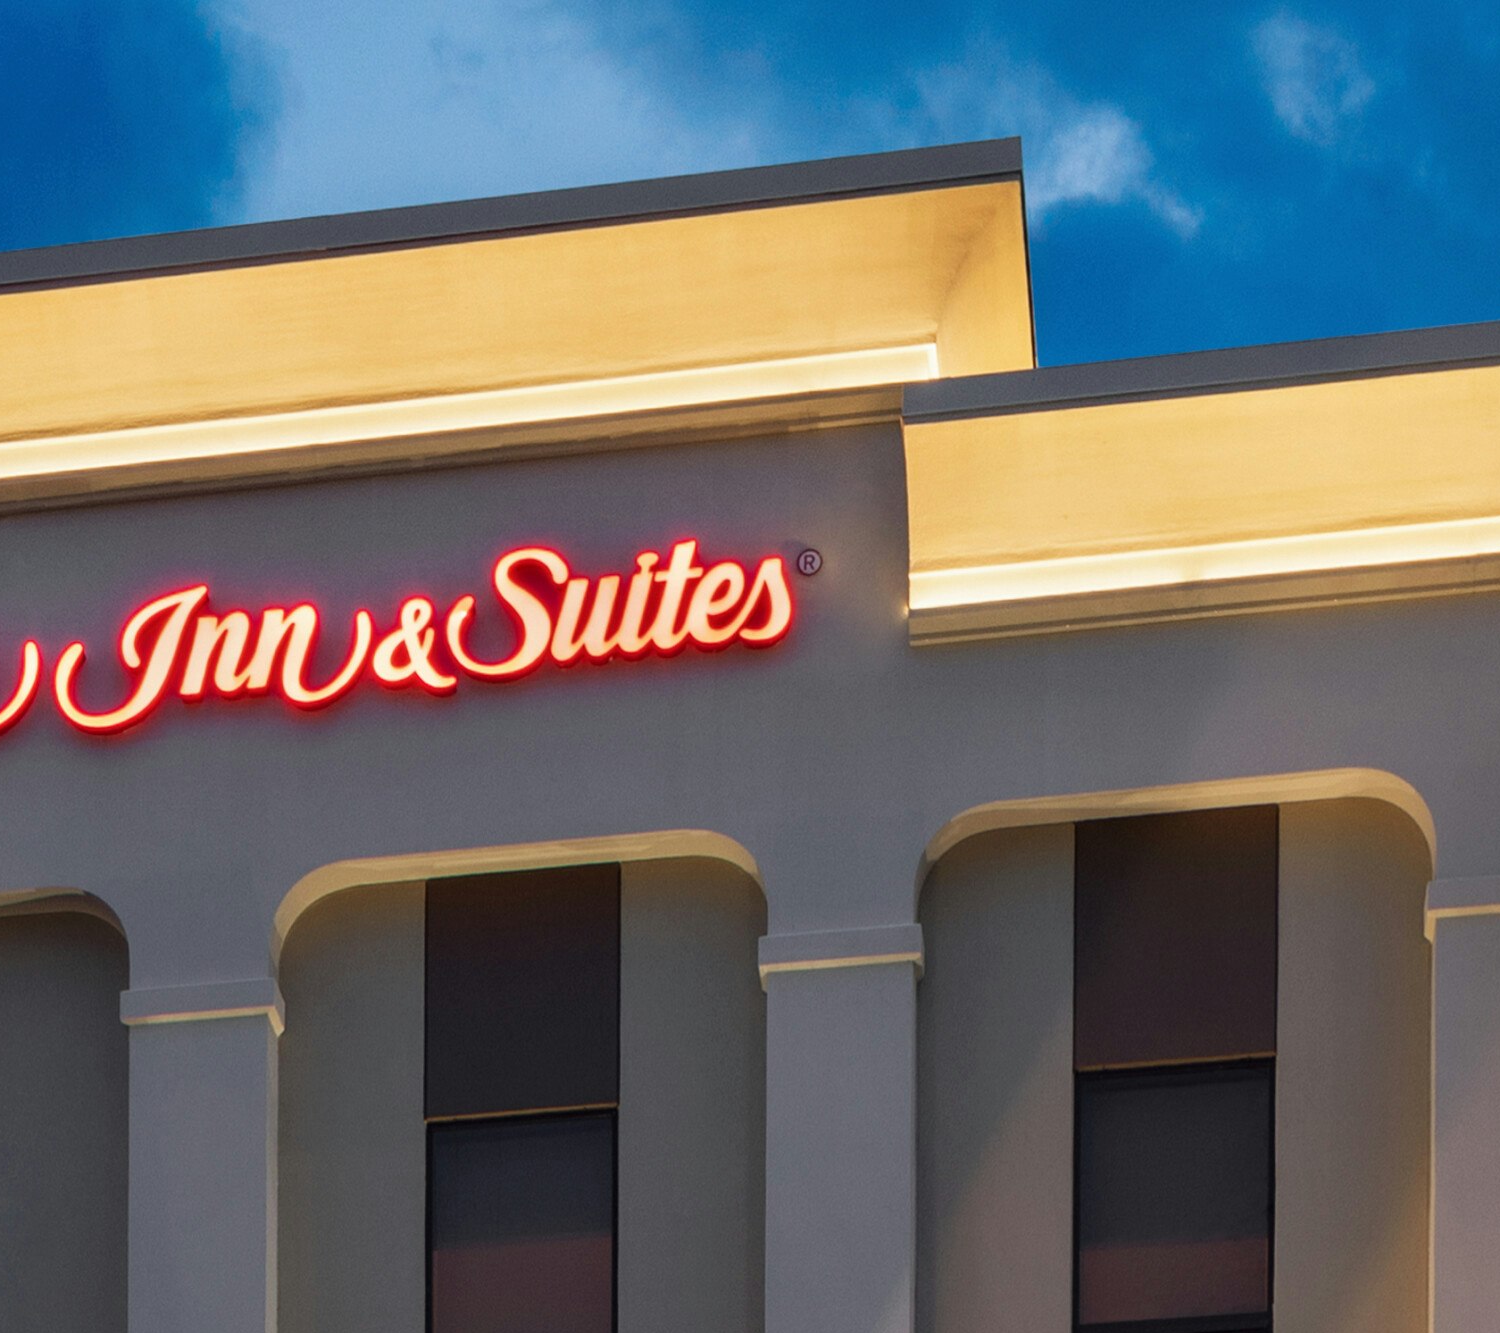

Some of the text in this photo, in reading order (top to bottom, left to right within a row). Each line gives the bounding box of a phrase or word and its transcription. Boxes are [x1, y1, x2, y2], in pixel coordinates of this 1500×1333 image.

[53, 583, 373, 734] Inn
[370, 596, 458, 694] &
[445, 538, 793, 682] Suites
